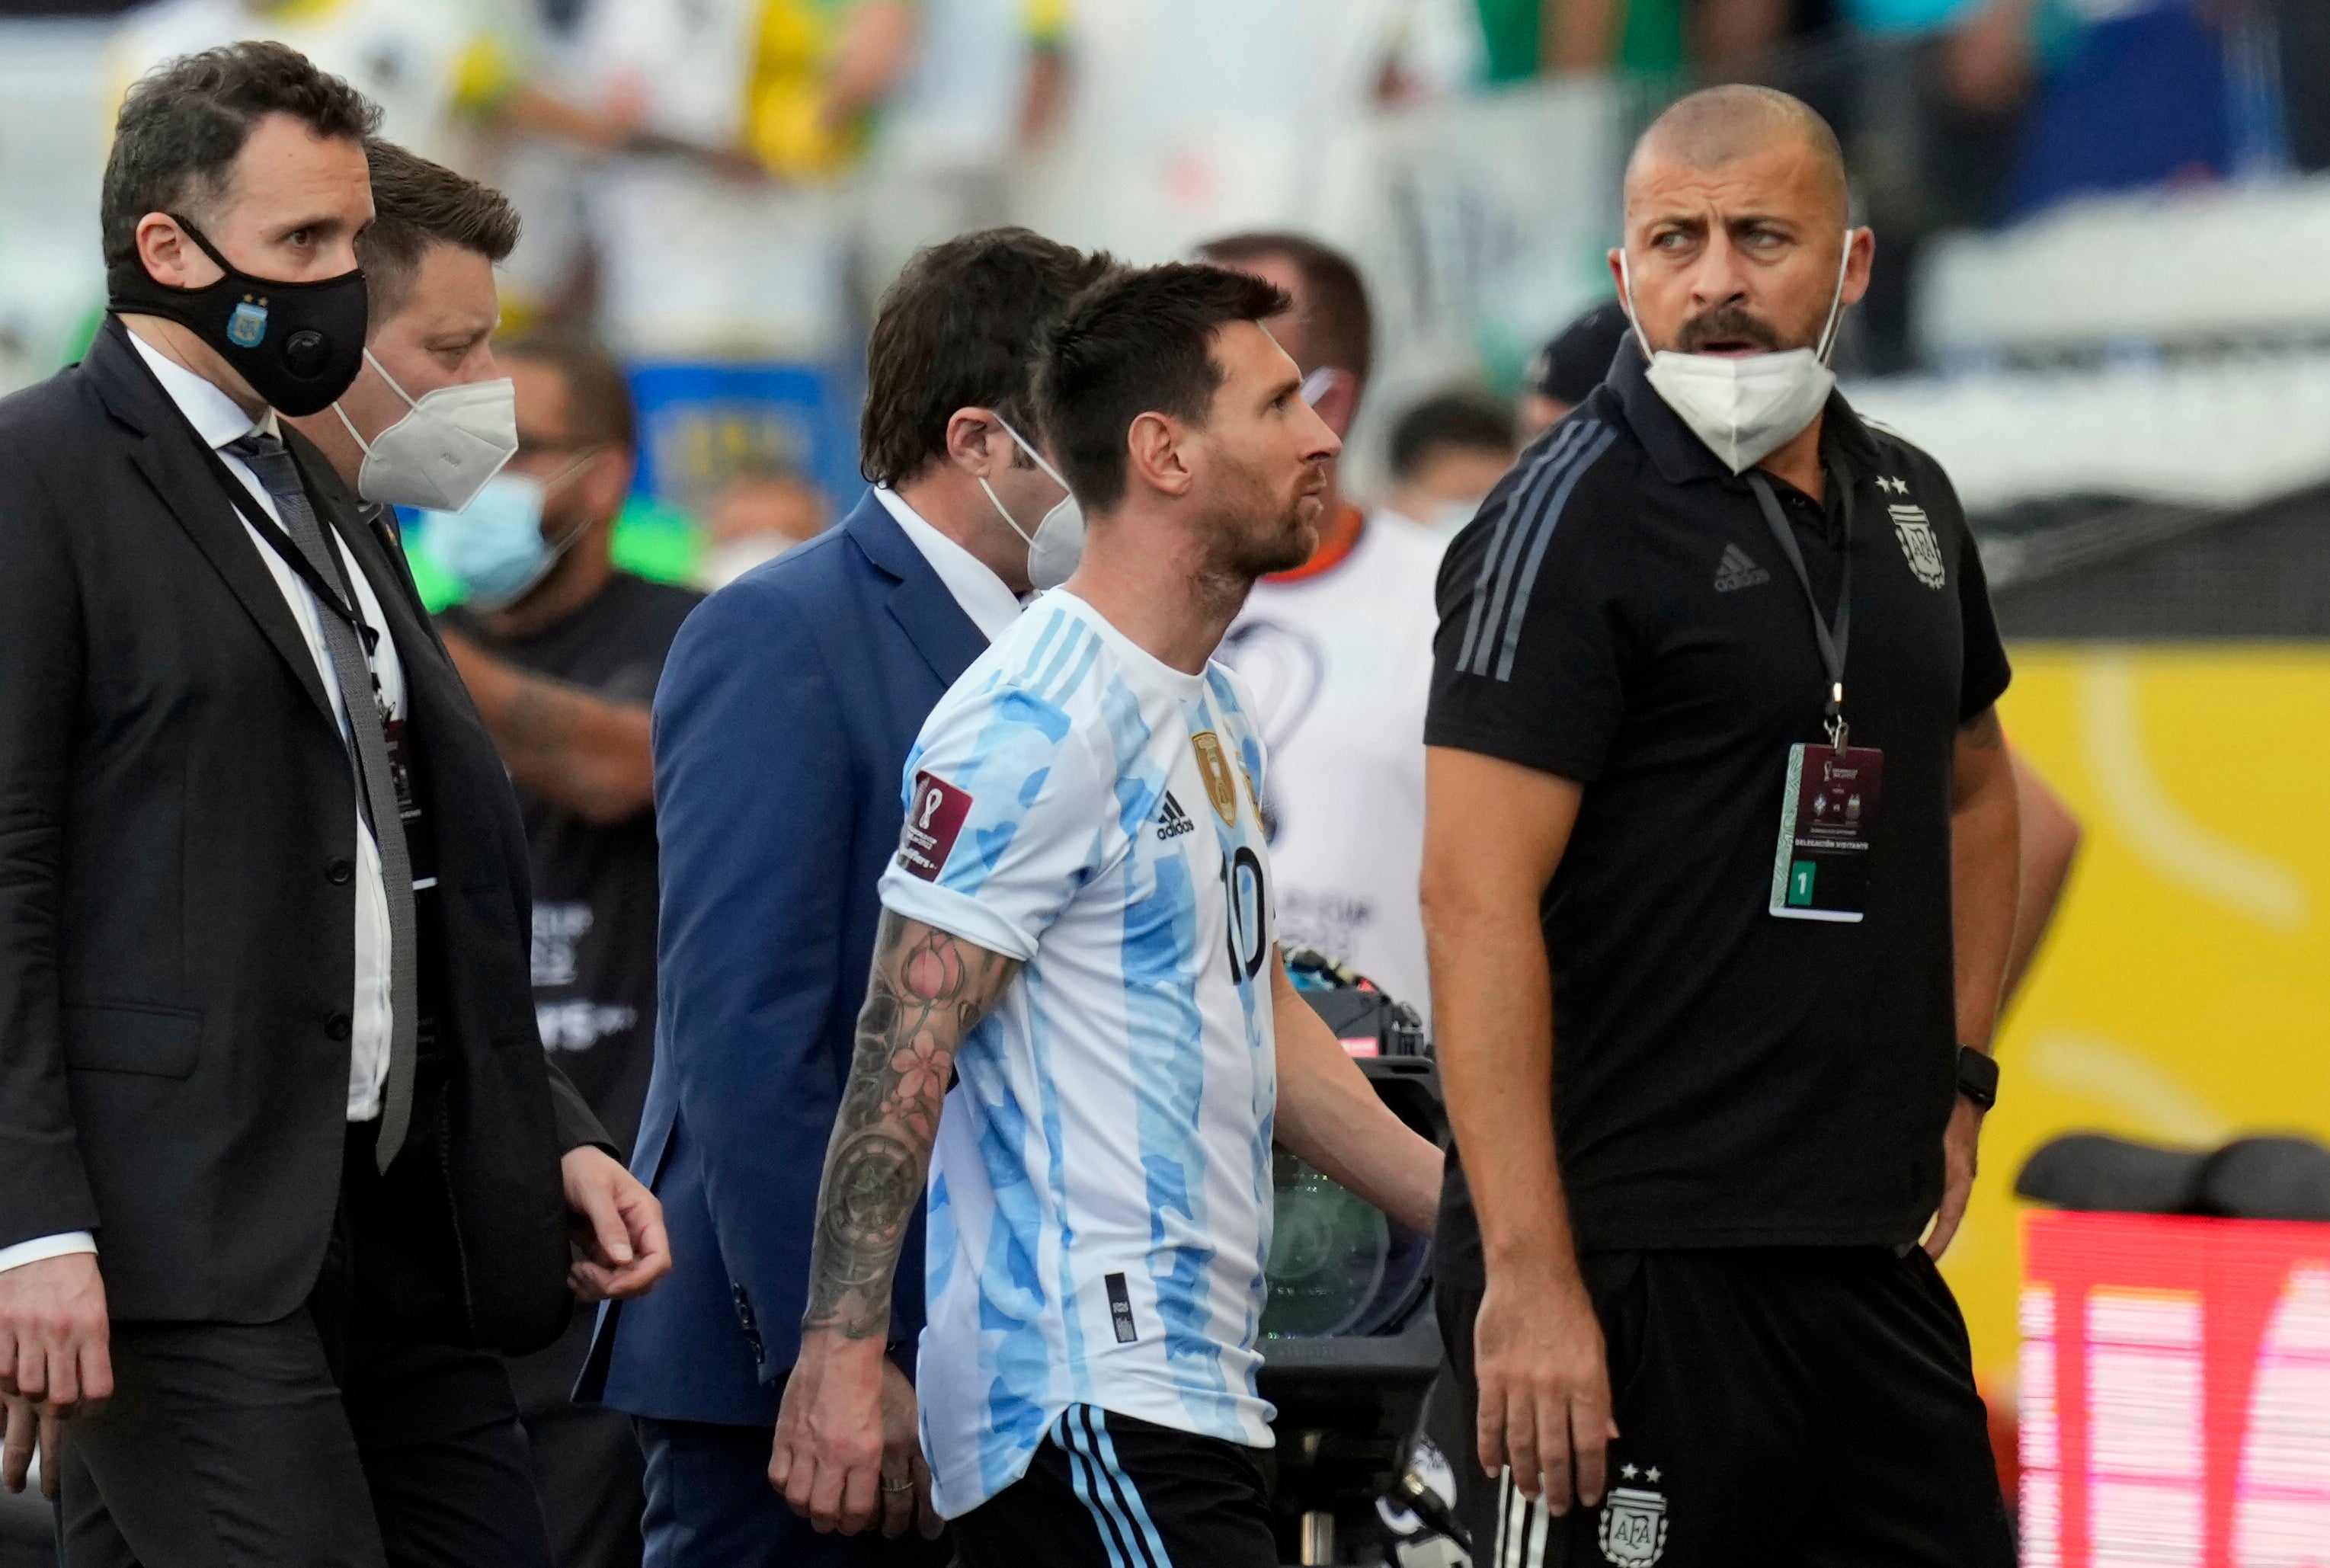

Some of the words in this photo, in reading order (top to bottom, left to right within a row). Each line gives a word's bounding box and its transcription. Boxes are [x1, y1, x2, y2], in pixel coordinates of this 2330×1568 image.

[1157, 818, 1195, 840] adidas
[1797, 872, 1807, 895] 1
[1221, 846, 1266, 986] 10
[1614, 1513, 1651, 1550] AFA
